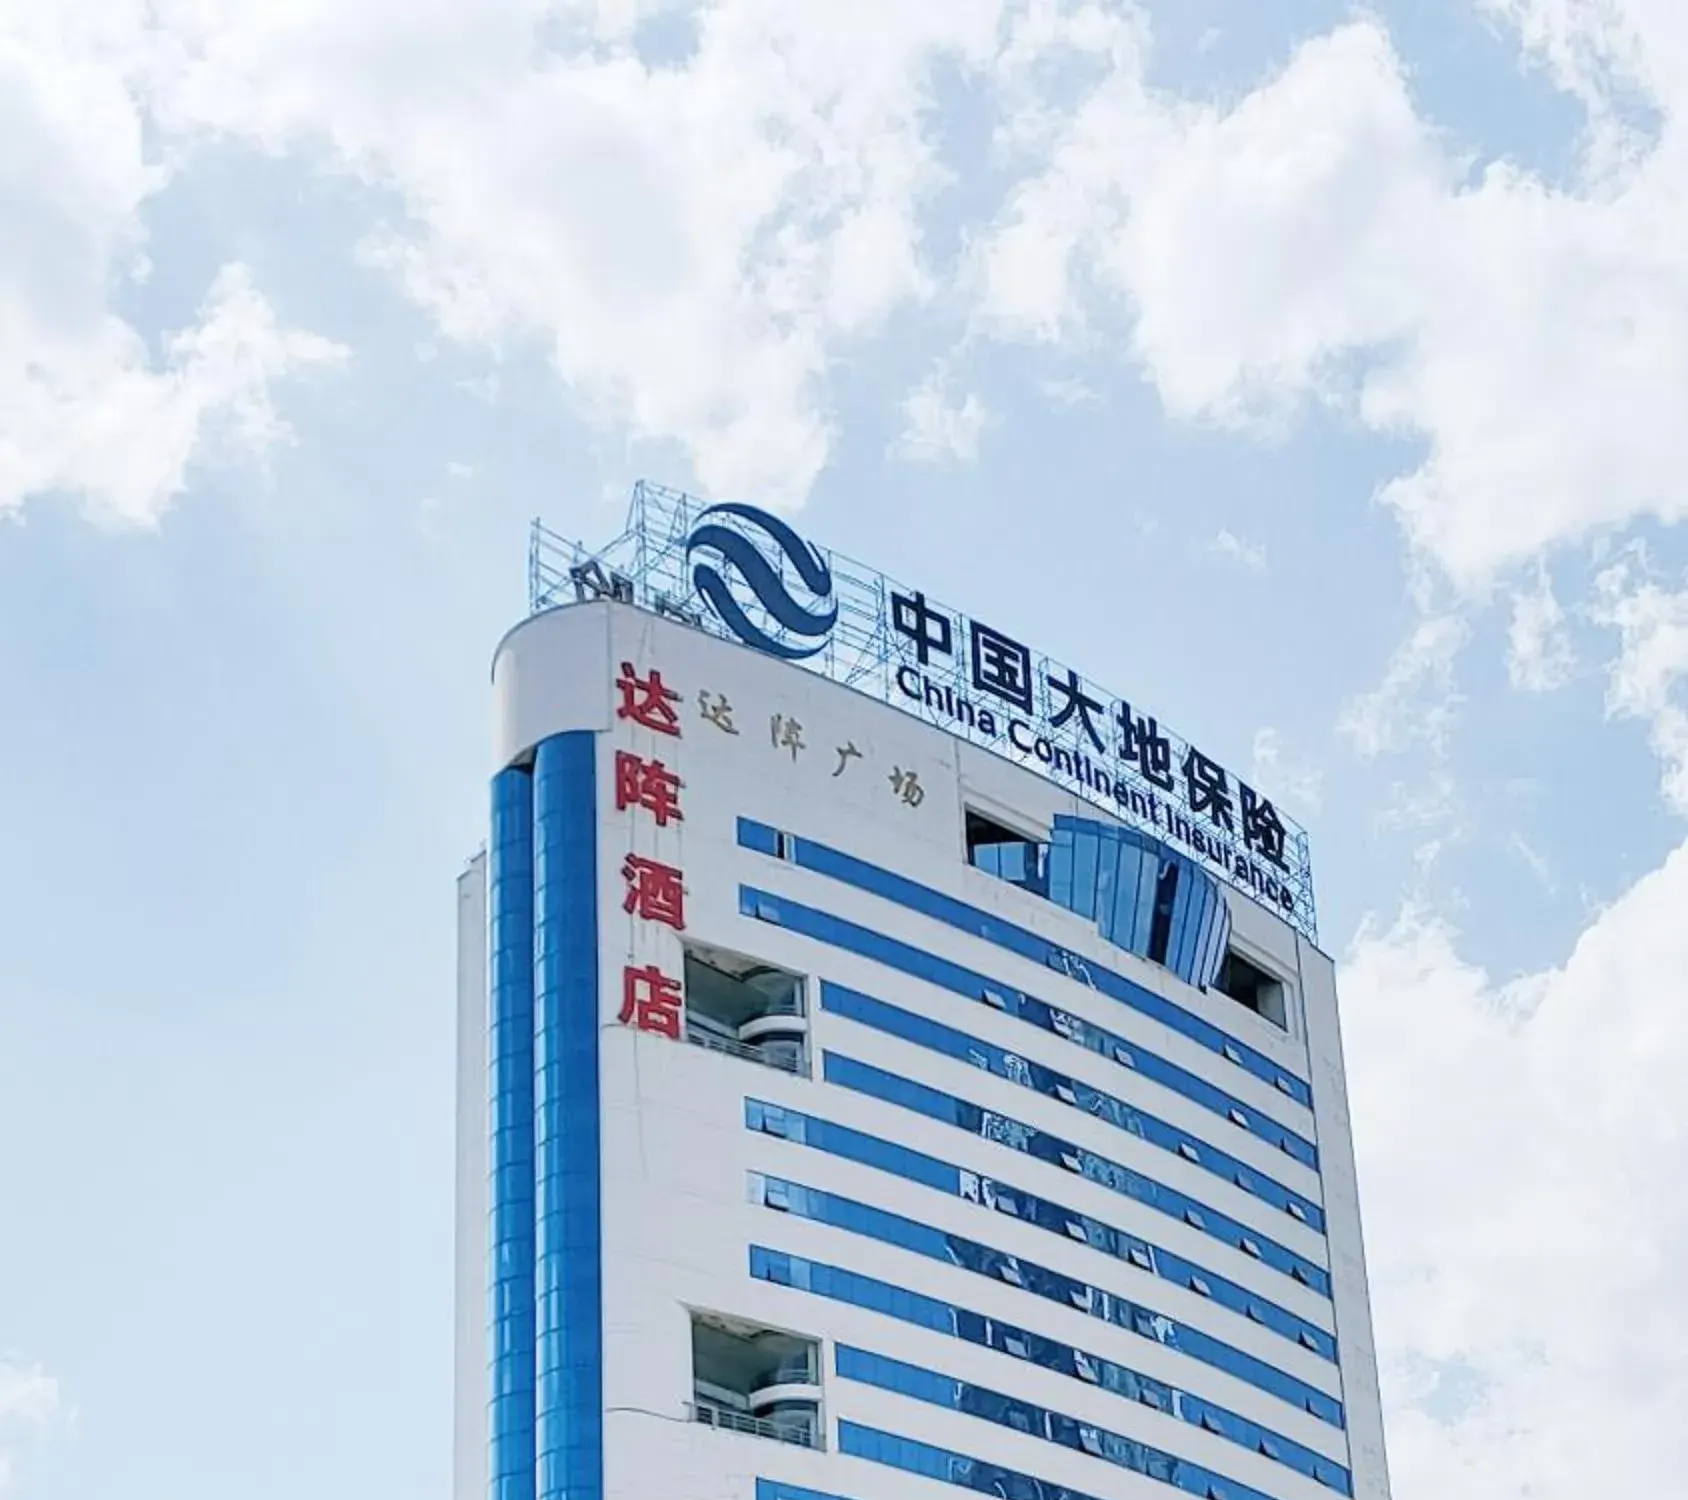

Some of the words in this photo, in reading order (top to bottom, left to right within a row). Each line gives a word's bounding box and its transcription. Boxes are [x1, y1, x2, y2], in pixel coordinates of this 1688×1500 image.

[615, 661, 687, 1041] 达阵酒店
[697, 689, 925, 807] 达阵广场
[891, 590, 1290, 874] 中国大地保险
[896, 665, 996, 738] China
[1008, 718, 1160, 825] Continent
[1167, 803, 1295, 912] Insurance
